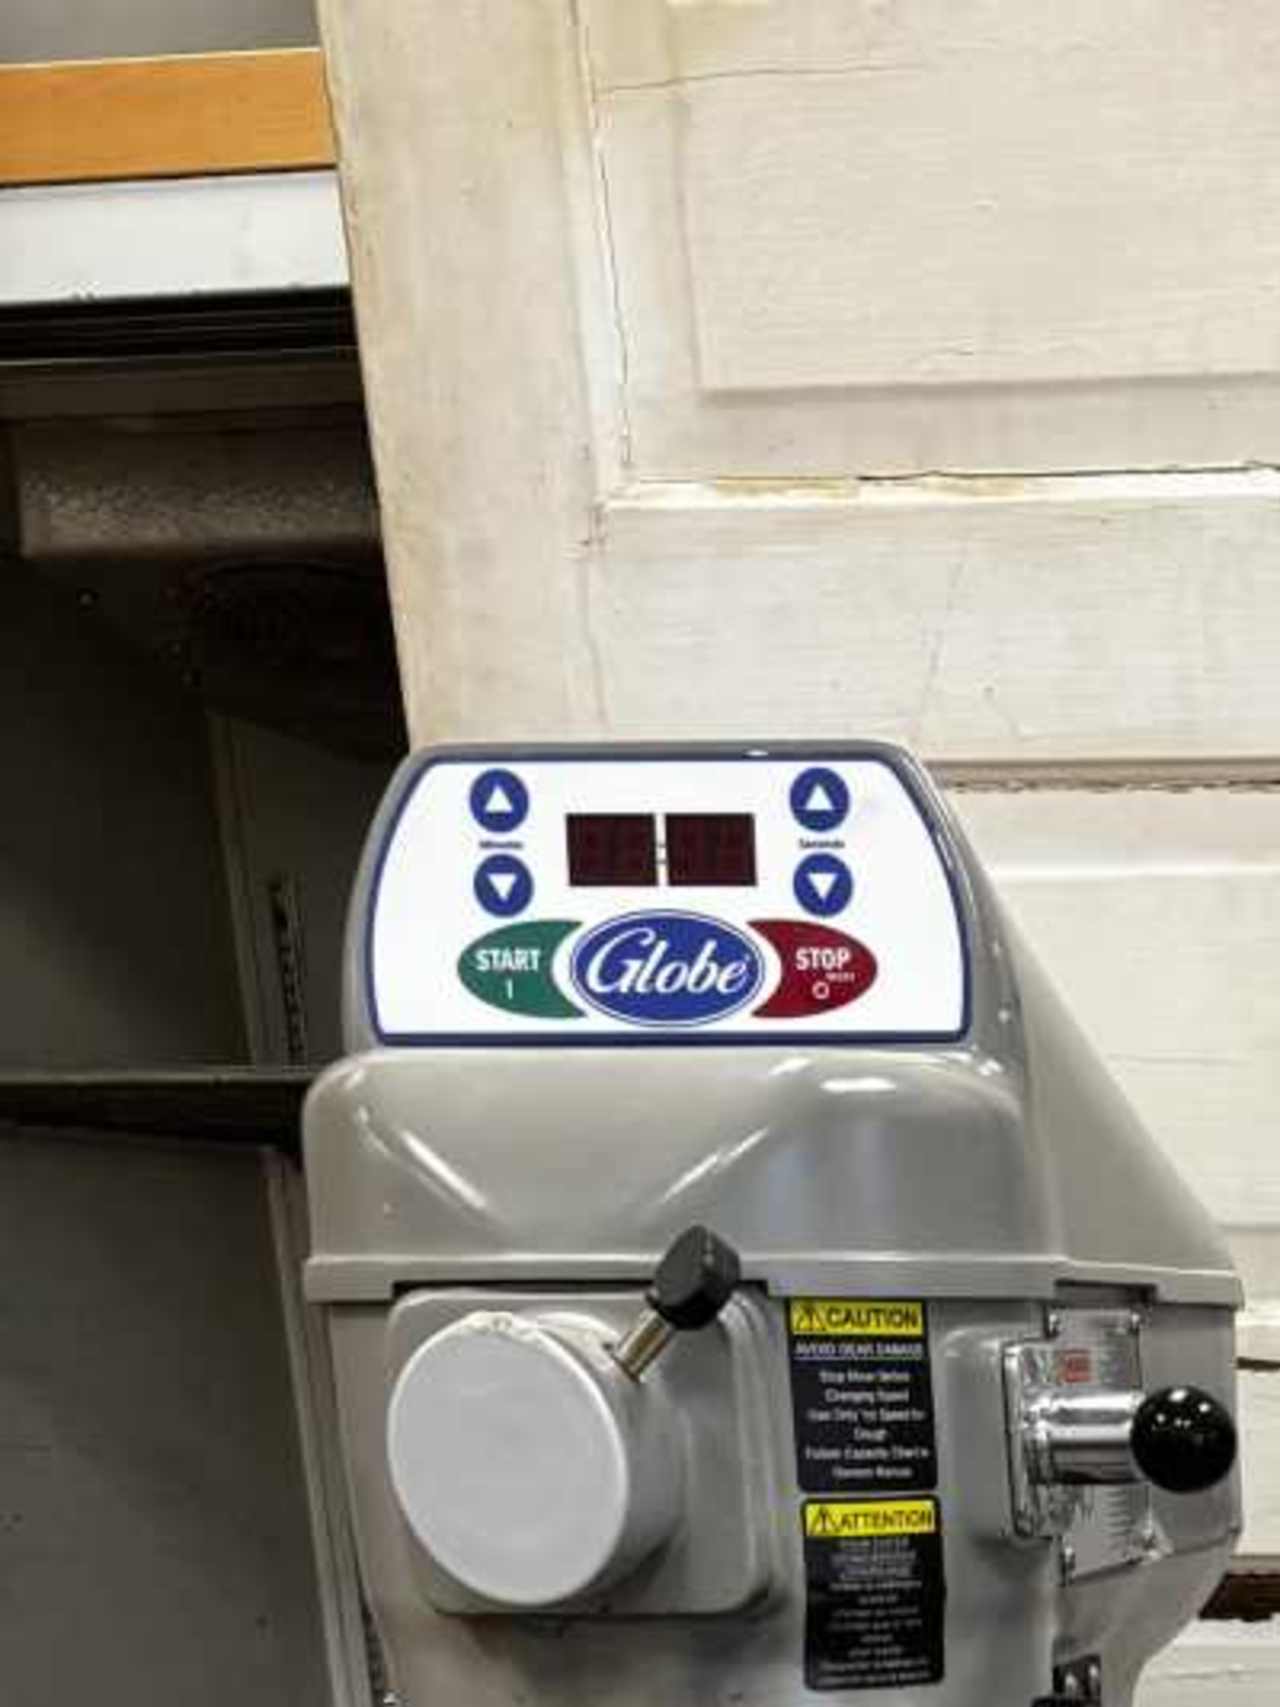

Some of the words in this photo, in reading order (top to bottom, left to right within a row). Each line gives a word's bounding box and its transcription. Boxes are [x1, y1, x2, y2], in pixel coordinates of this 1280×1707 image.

[475, 946, 541, 972] START
[586, 926, 750, 994] Globe
[795, 946, 851, 971] STOP
[825, 1306, 918, 1329] CAUTION
[840, 1508, 932, 1531] ATTENTION
